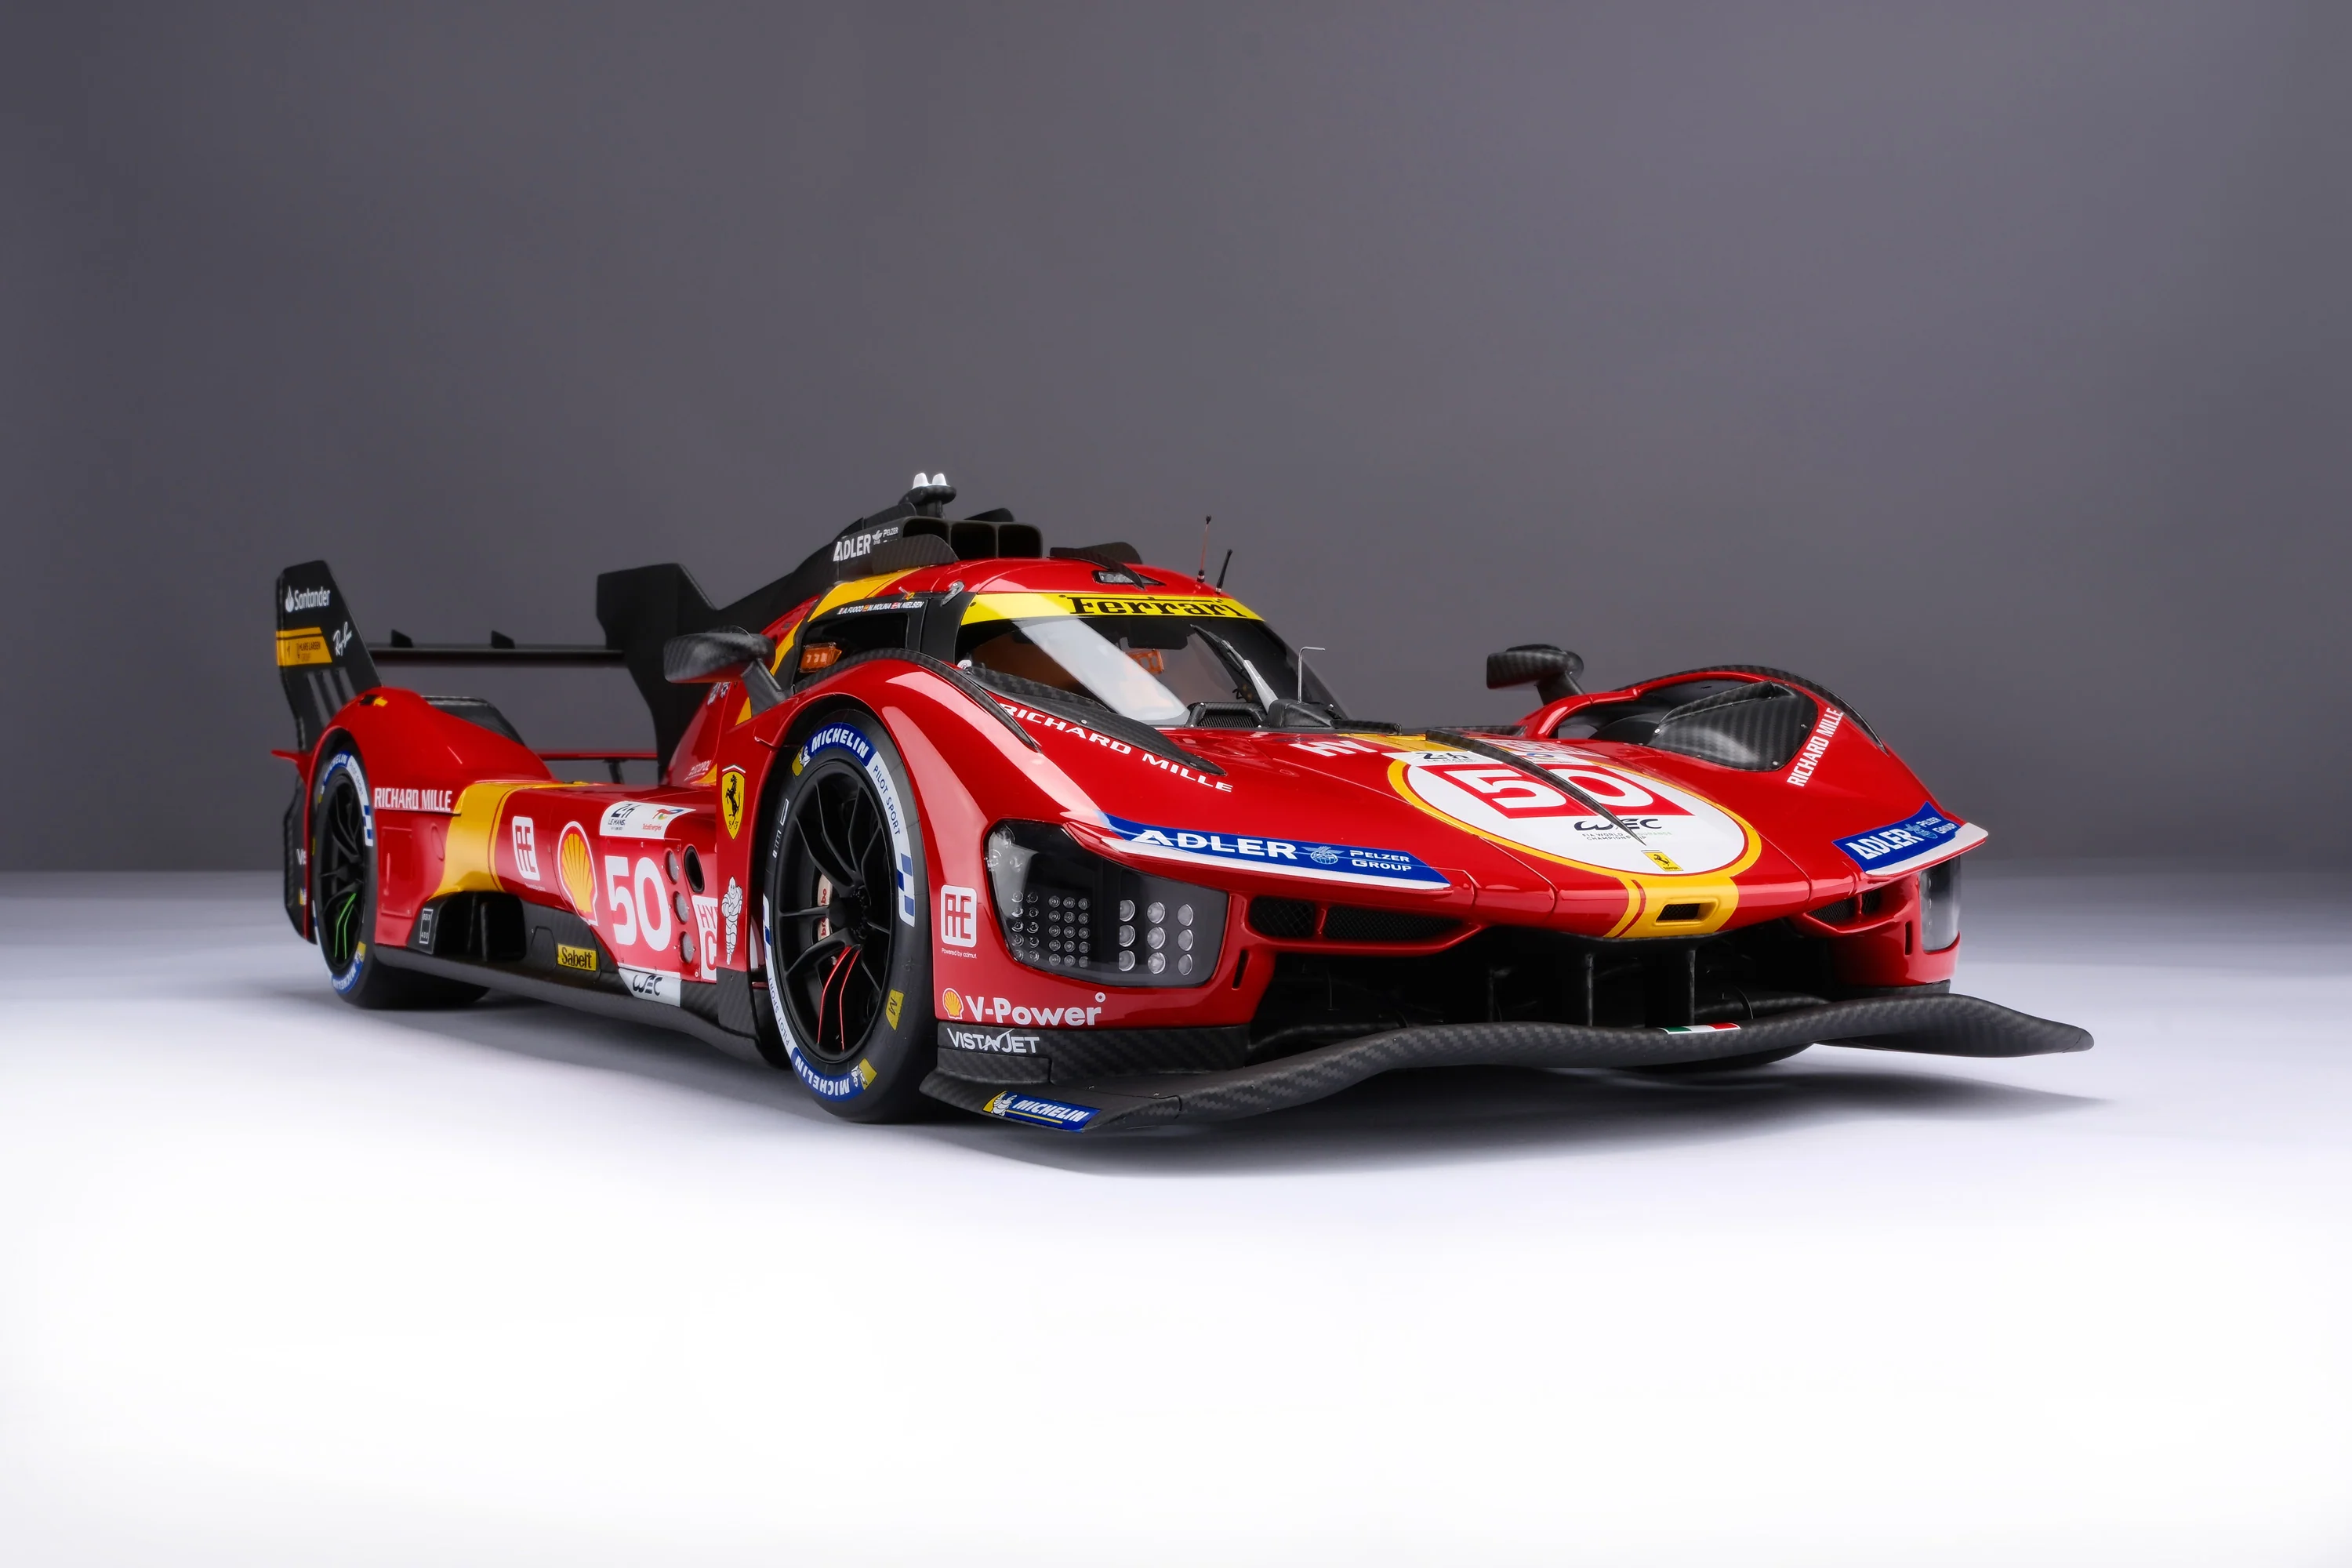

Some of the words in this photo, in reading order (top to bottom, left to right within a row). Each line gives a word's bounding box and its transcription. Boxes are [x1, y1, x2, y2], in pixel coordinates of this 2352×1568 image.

[833, 534, 871, 561] ADLER
[294, 586, 331, 611] Santander
[1066, 597, 1248, 618] Ferrari
[811, 728, 869, 759] MICHELIN
[999, 702, 1132, 755] RICHARD
[1142, 753, 1233, 793] MILLE
[1786, 735, 1830, 787] RICHARD
[1816, 707, 1844, 738] MILLE
[374, 787, 419, 810] RICHARD
[421, 789, 452, 811] MILLE
[873, 764, 889, 795] PILOT
[886, 797, 901, 835] SPORT
[1443, 769, 1653, 809] 50
[1131, 829, 1298, 860] ADLER
[1349, 849, 1410, 862] PELZER
[1845, 828, 1925, 860] ADLER
[1352, 859, 1412, 872] GROUP
[604, 855, 672, 952] 50
[561, 948, 593, 969] Sabelt
[942, 947, 956, 956] Powered
[632, 974, 663, 996] WEC
[965, 995, 1102, 1026] V-Power
[794, 1055, 851, 1097] MICHELIN
[1012, 1099, 1090, 1123] MICHELIN
